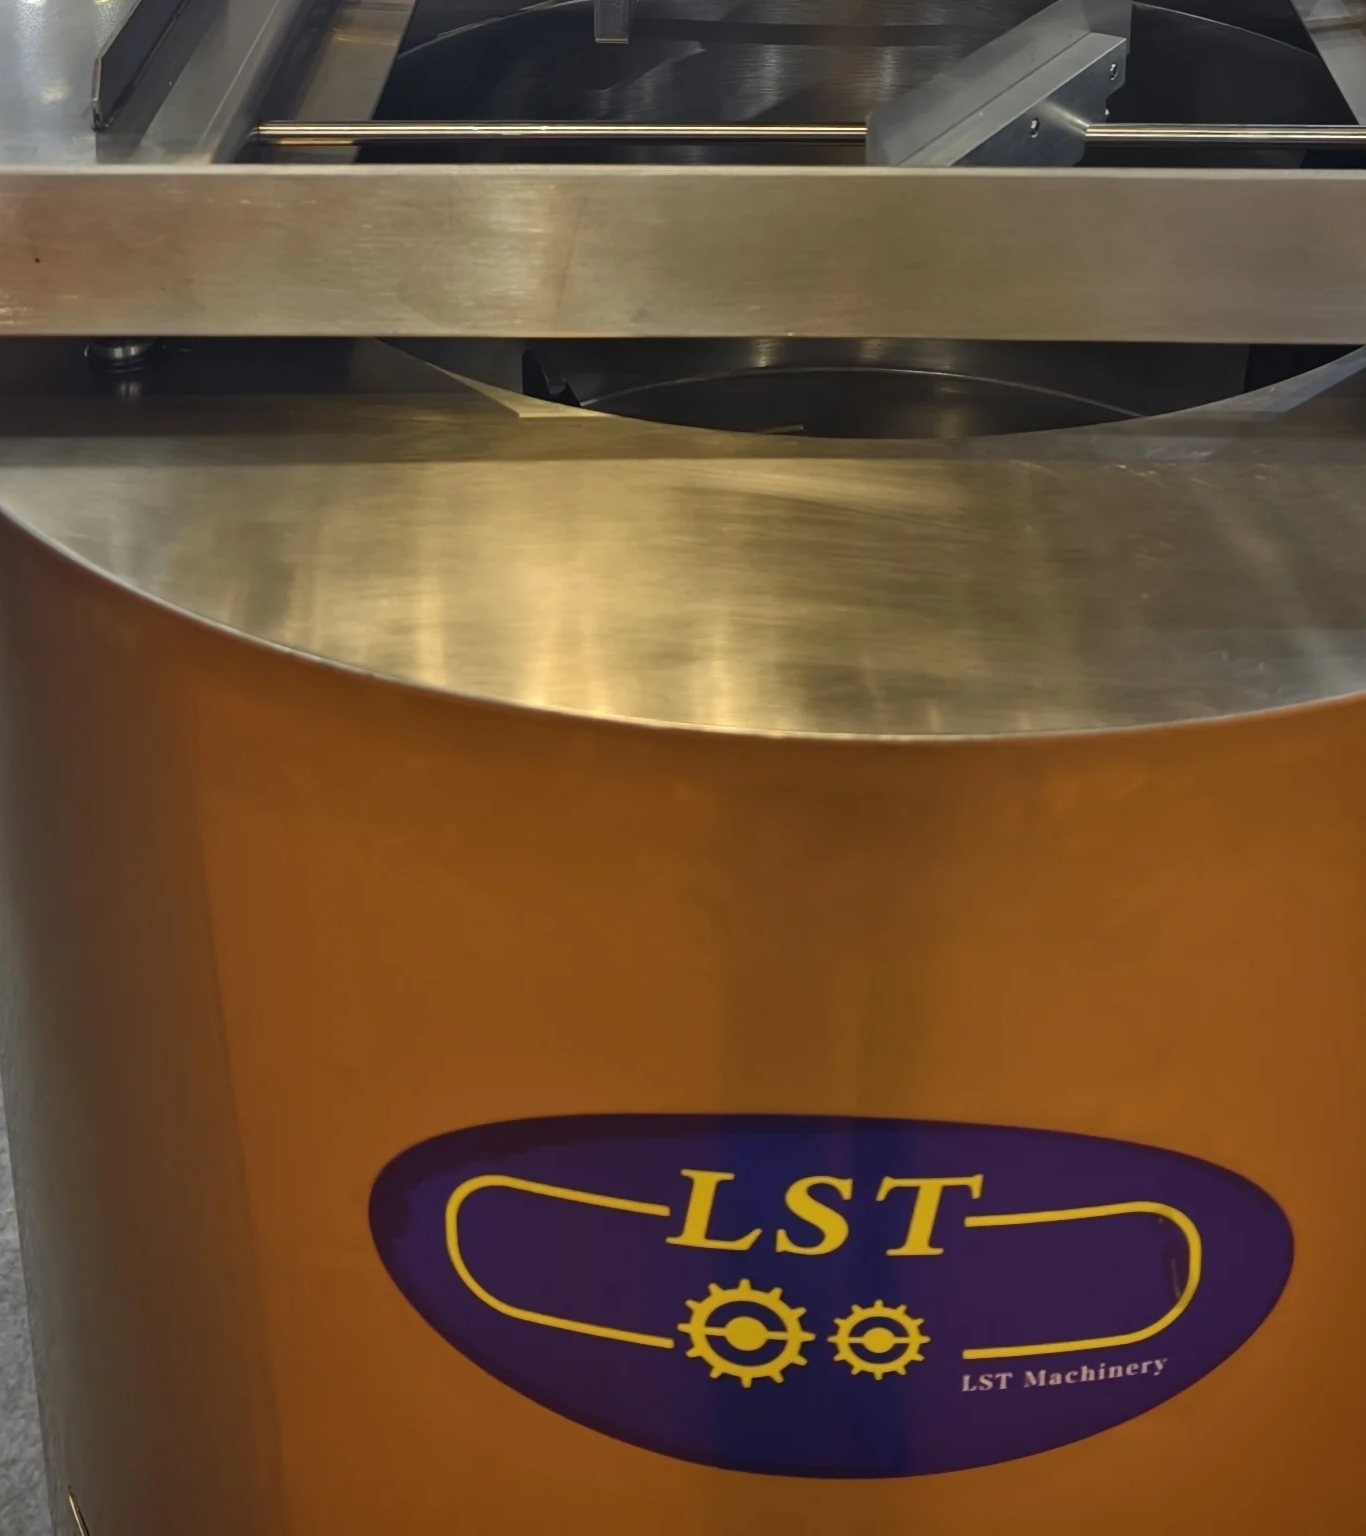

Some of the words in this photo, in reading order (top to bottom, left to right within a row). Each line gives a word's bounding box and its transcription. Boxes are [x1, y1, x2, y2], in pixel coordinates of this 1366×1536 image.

[665, 1168, 984, 1257] LST
[961, 1372, 1014, 1392] LST
[1023, 1357, 1169, 1388] Machinery
